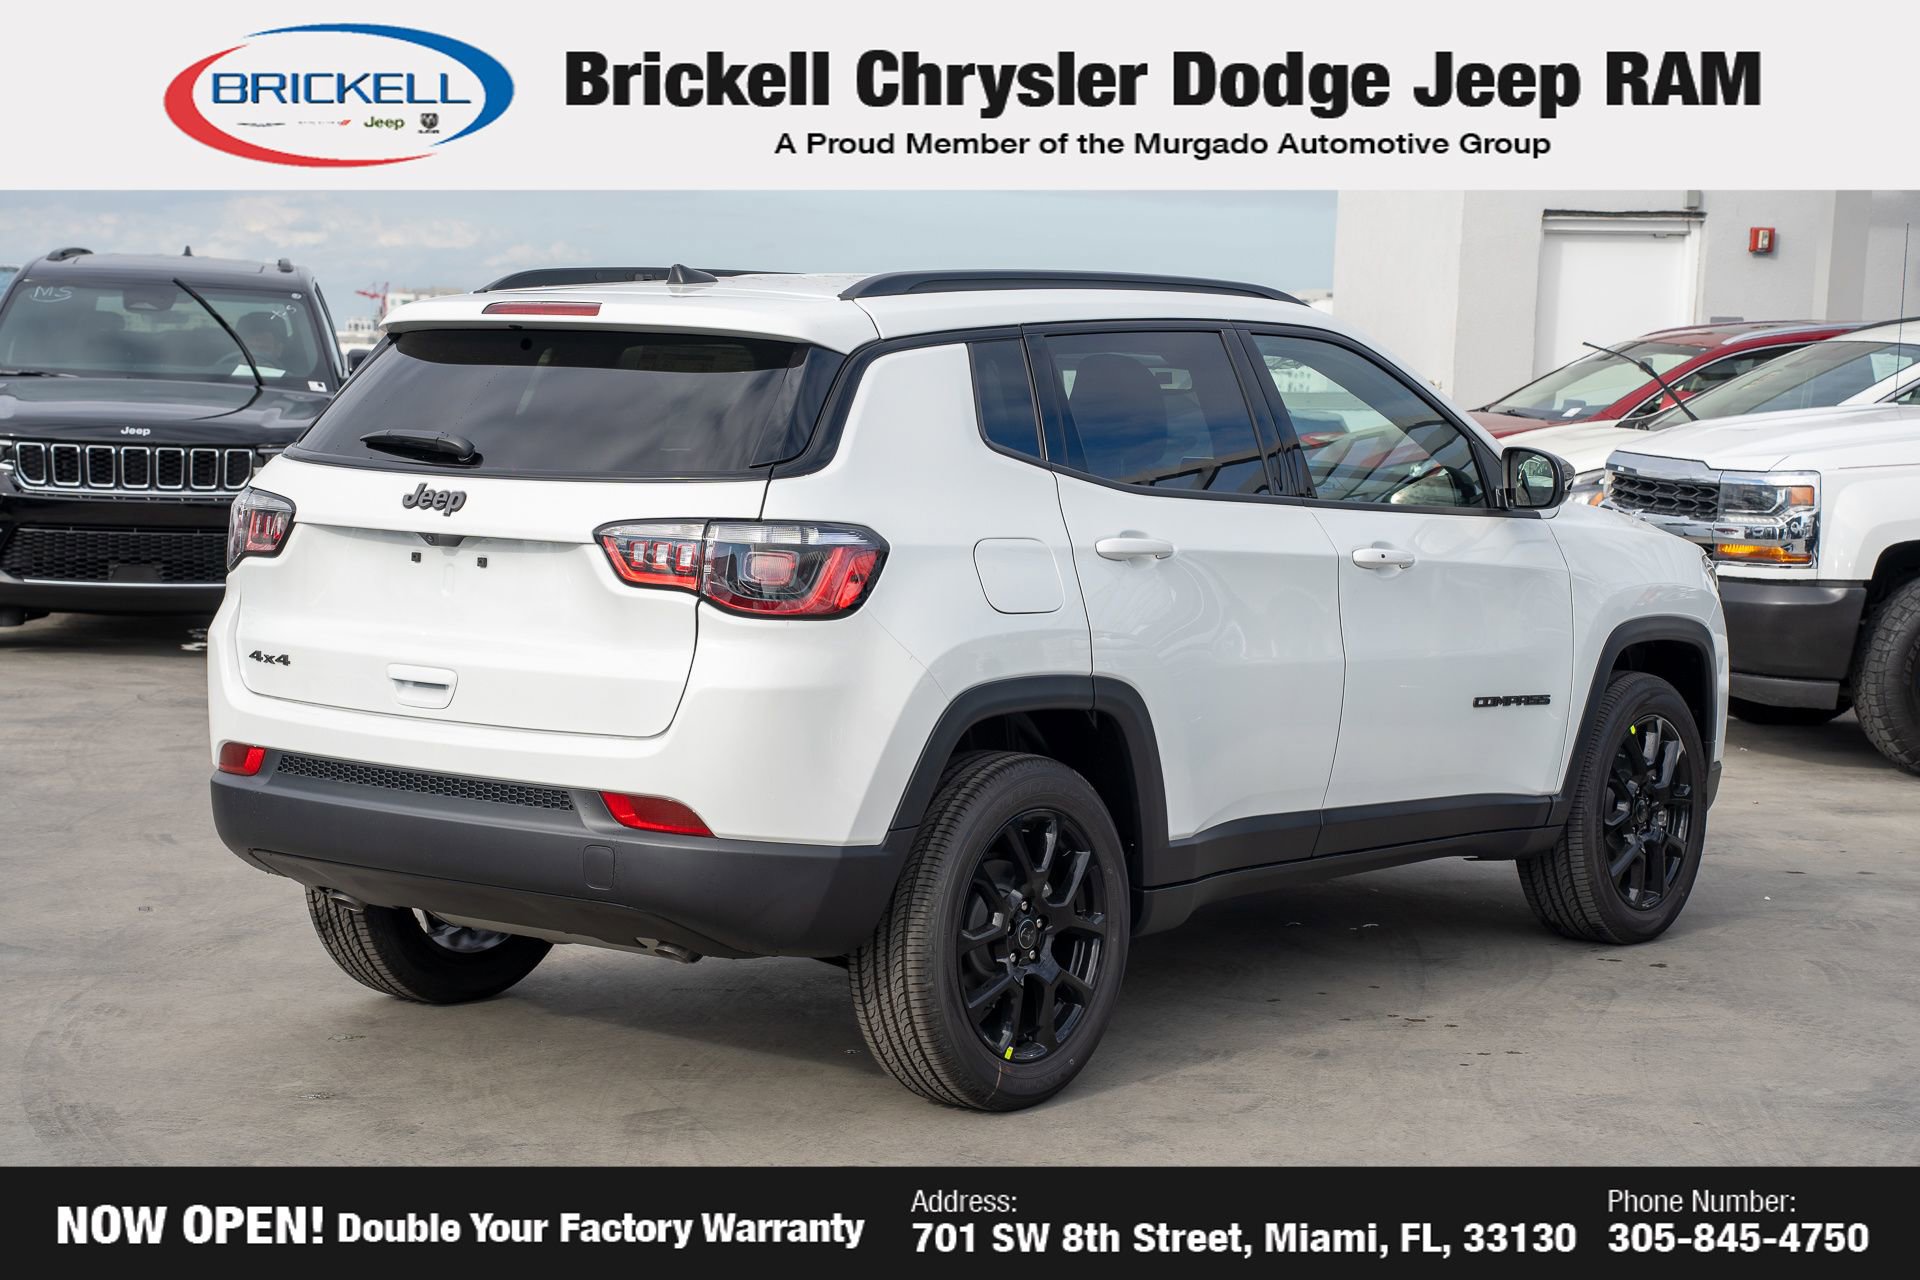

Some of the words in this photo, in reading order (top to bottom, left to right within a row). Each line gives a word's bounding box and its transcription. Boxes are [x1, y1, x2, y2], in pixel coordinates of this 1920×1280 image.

[120, 426, 151, 437] Jeep
[402, 482, 468, 517] Jeep
[248, 649, 291, 667] 4x4
[1472, 694, 1551, 708] COMPASS
